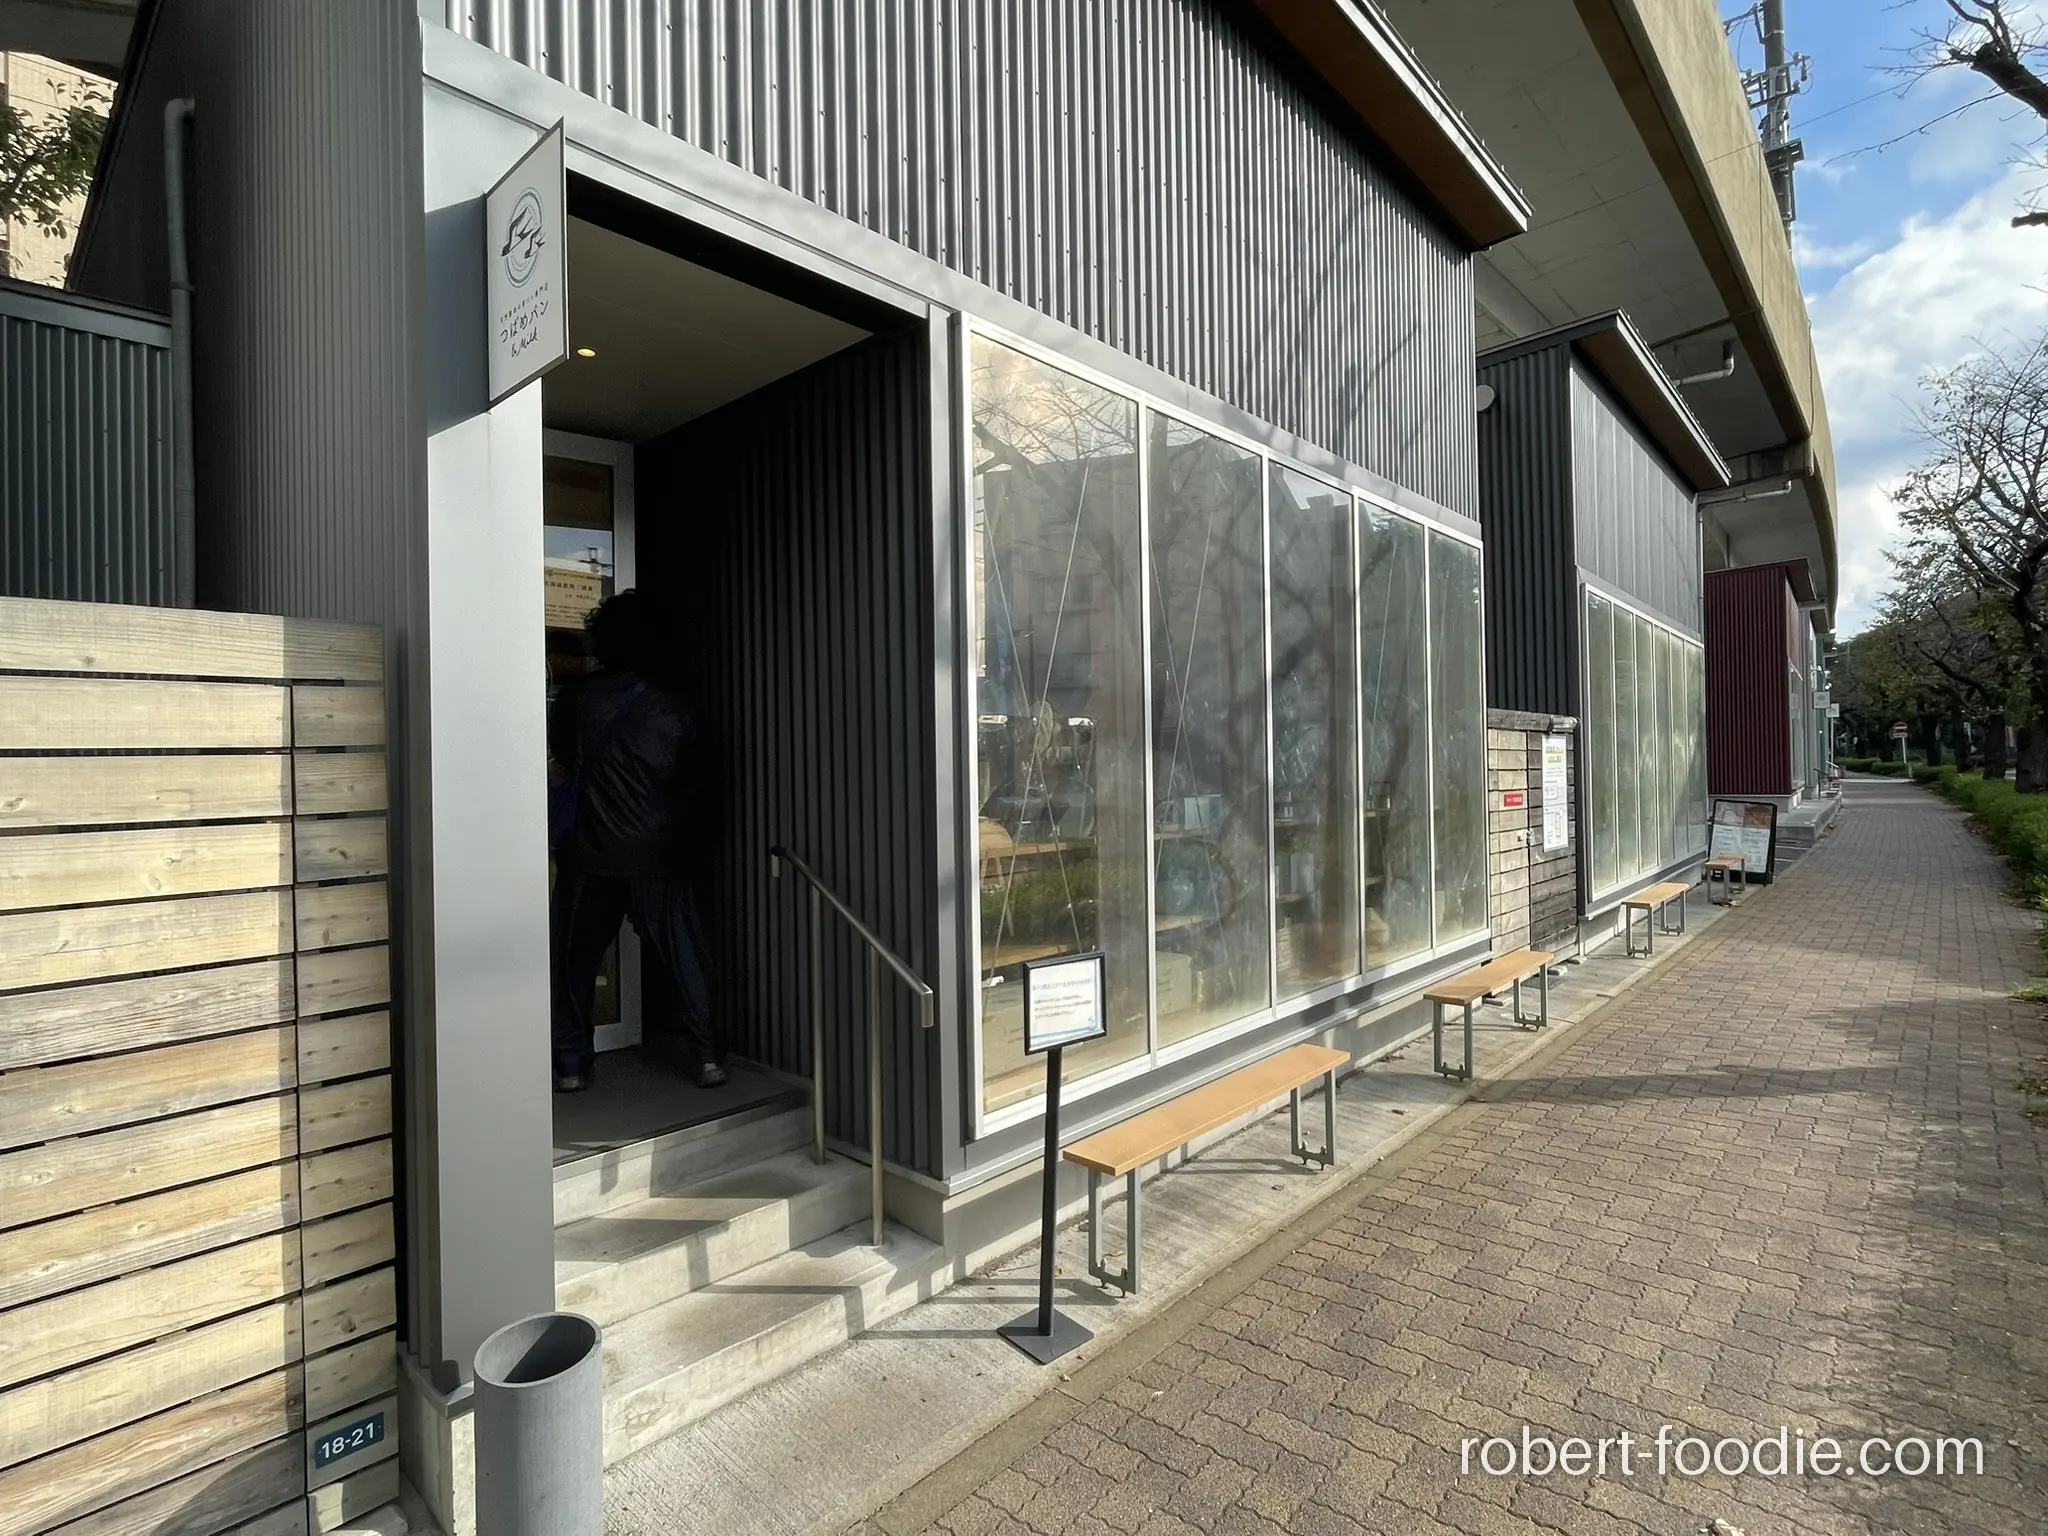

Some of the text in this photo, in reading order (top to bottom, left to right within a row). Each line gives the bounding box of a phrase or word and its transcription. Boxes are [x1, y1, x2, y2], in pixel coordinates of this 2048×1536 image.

[500, 299, 549, 343] つばめパン
[321, 1421, 375, 1459] 18-21
